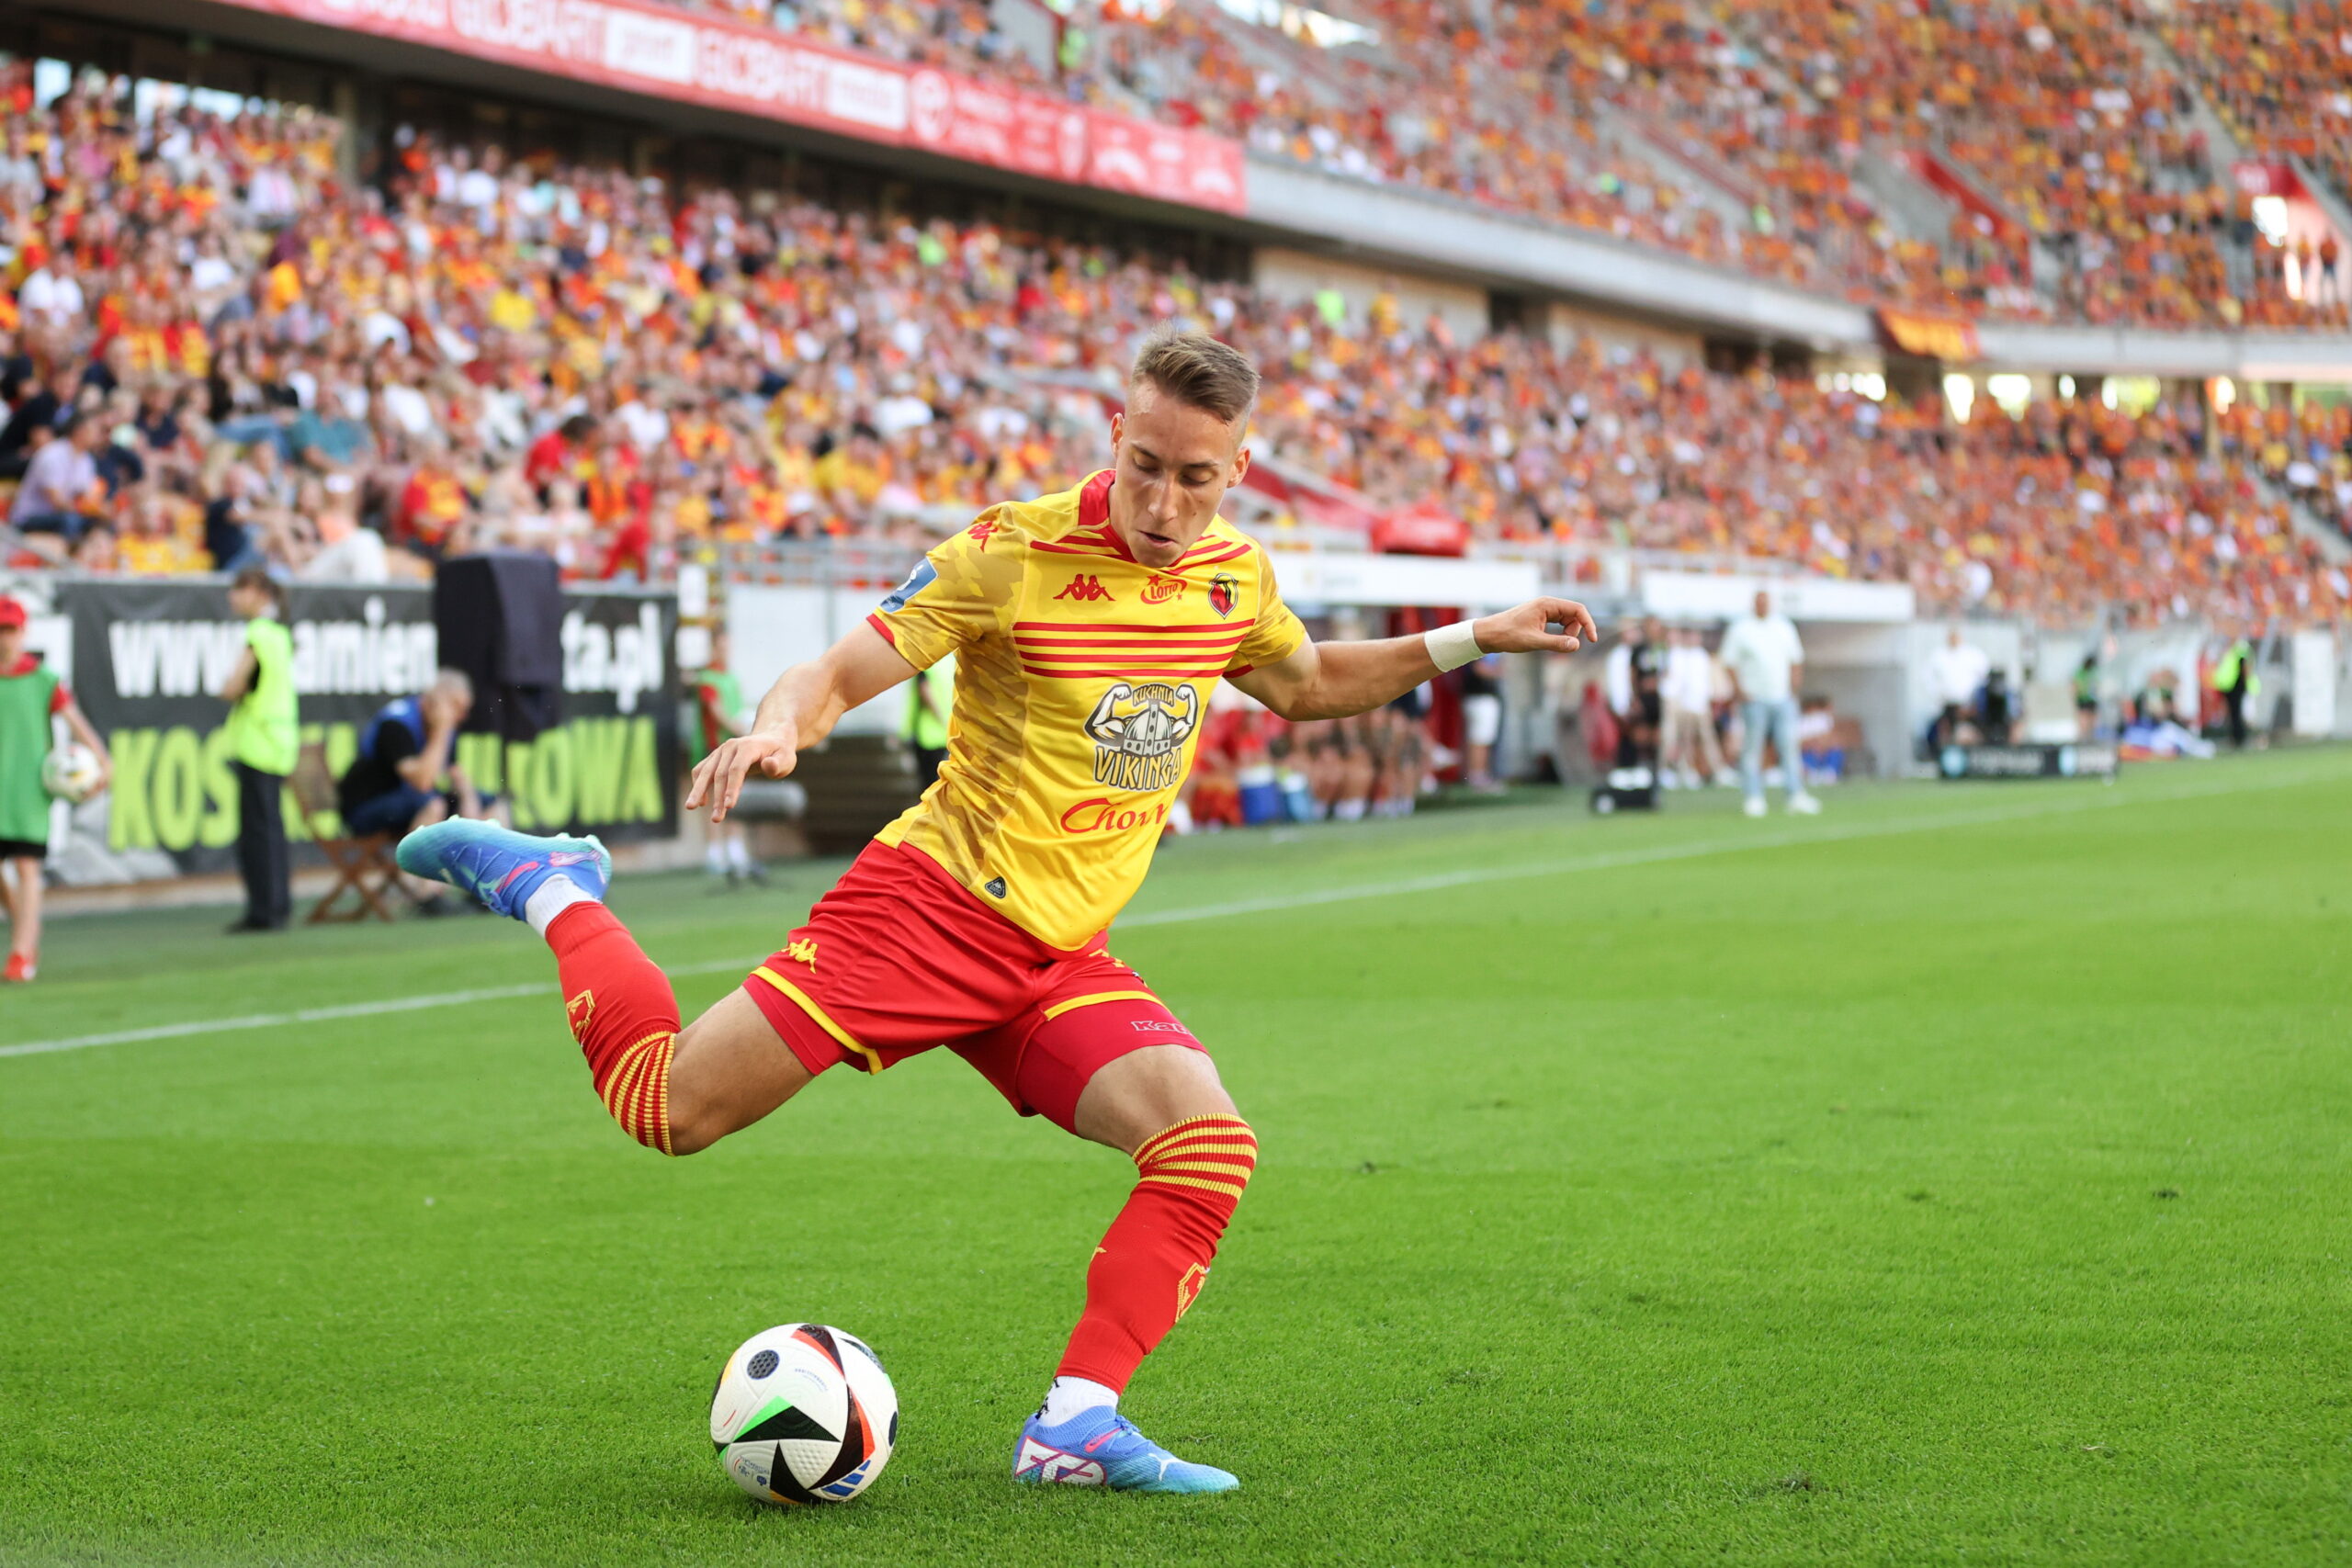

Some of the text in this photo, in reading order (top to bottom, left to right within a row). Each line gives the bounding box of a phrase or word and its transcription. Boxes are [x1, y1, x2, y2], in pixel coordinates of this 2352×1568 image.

[1150, 582, 1179, 600] LOTTO
[1133, 684, 1175, 707] KUCHNIA
[1095, 746, 1182, 792] VIKINGA
